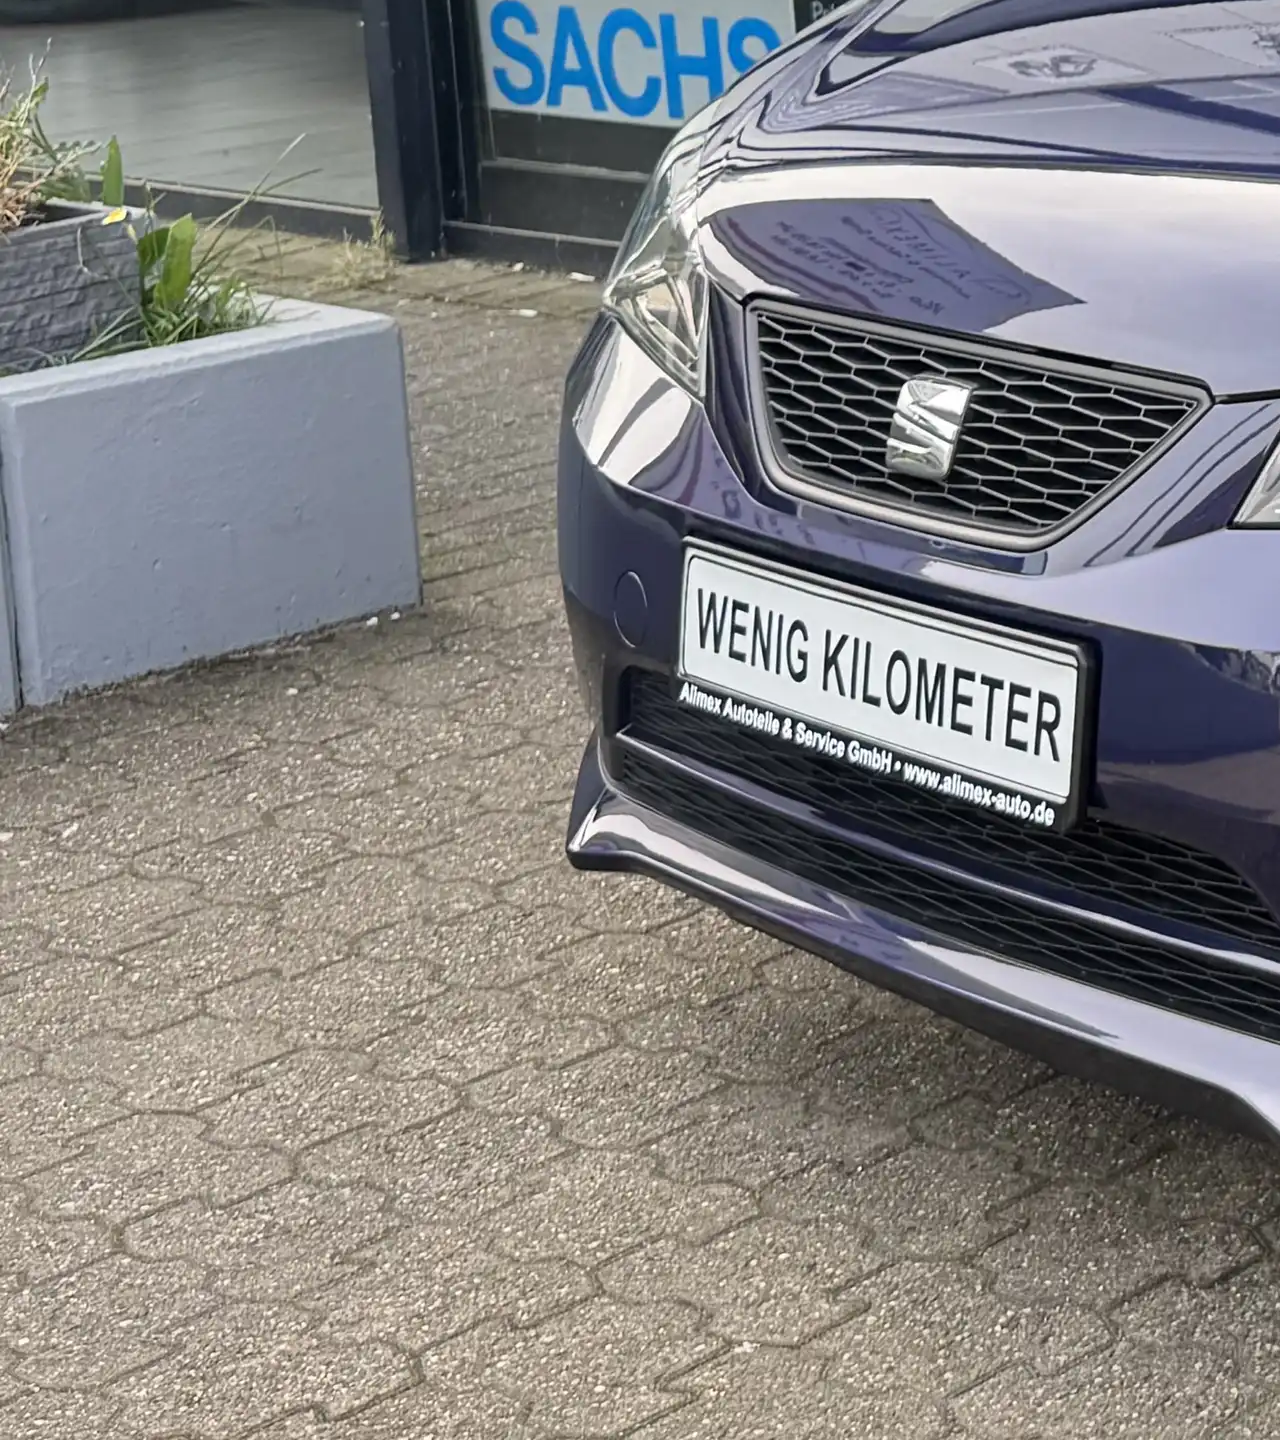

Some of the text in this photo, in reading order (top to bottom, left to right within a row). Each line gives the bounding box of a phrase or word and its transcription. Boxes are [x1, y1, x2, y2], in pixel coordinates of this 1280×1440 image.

[697, 588, 1062, 763] WENIG KILOMETER
[782, 718, 793, 740] &
[794, 722, 845, 758] Service
[847, 740, 893, 774] GmbH
